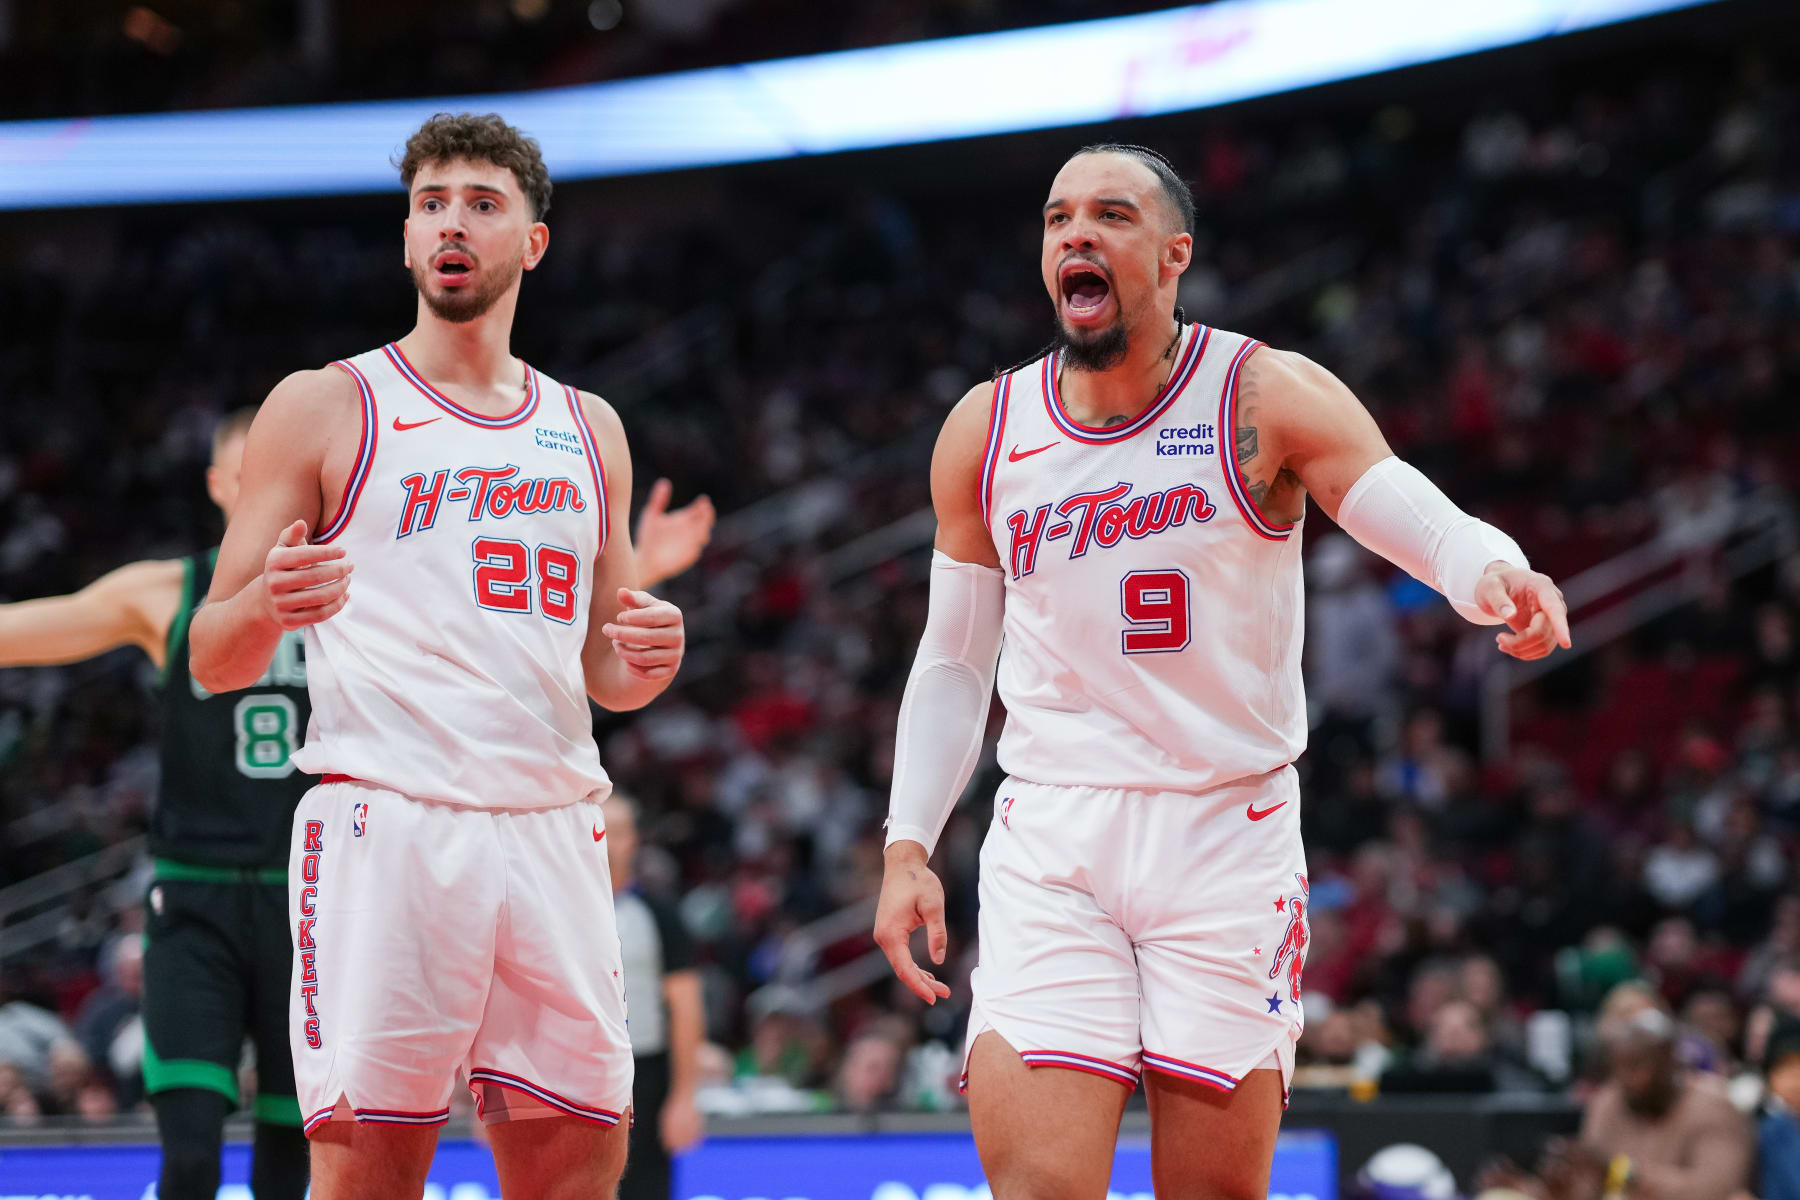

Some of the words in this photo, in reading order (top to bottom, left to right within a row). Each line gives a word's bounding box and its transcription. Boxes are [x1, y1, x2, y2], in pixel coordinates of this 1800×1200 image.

[535, 427, 580, 444] credit
[535, 436, 583, 456] karma
[1156, 441, 1215, 456] karma
[1159, 424, 1215, 440] credit
[397, 463, 587, 540] H-Town
[1007, 481, 1217, 581] H-Town
[471, 535, 581, 626] 28
[1120, 568, 1192, 655] 9
[234, 693, 298, 779] 8
[298, 819, 325, 1050] ROCKETS
